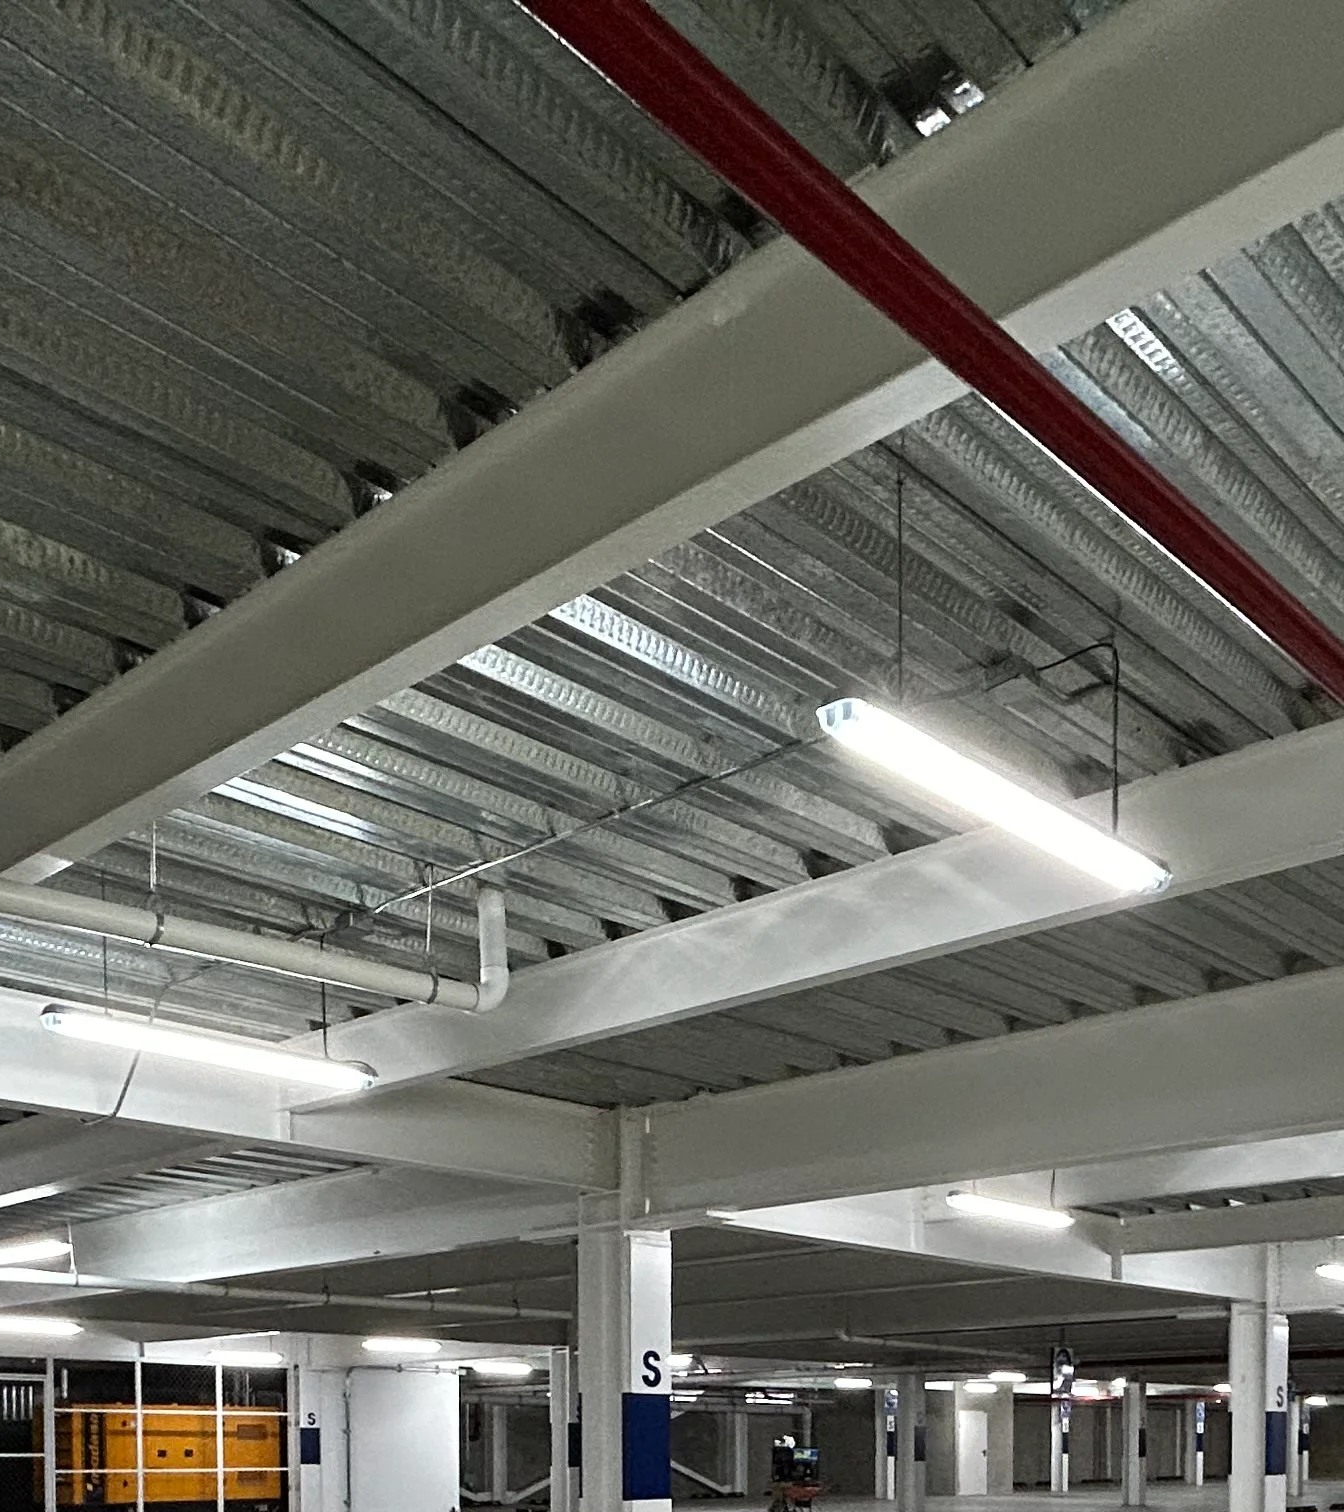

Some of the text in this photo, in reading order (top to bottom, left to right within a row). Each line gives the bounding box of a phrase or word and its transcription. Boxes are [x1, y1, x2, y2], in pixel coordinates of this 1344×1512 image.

[641, 1350, 662, 1388] S
[1276, 1385, 1284, 1408] S
[307, 1412, 316, 1426] S
